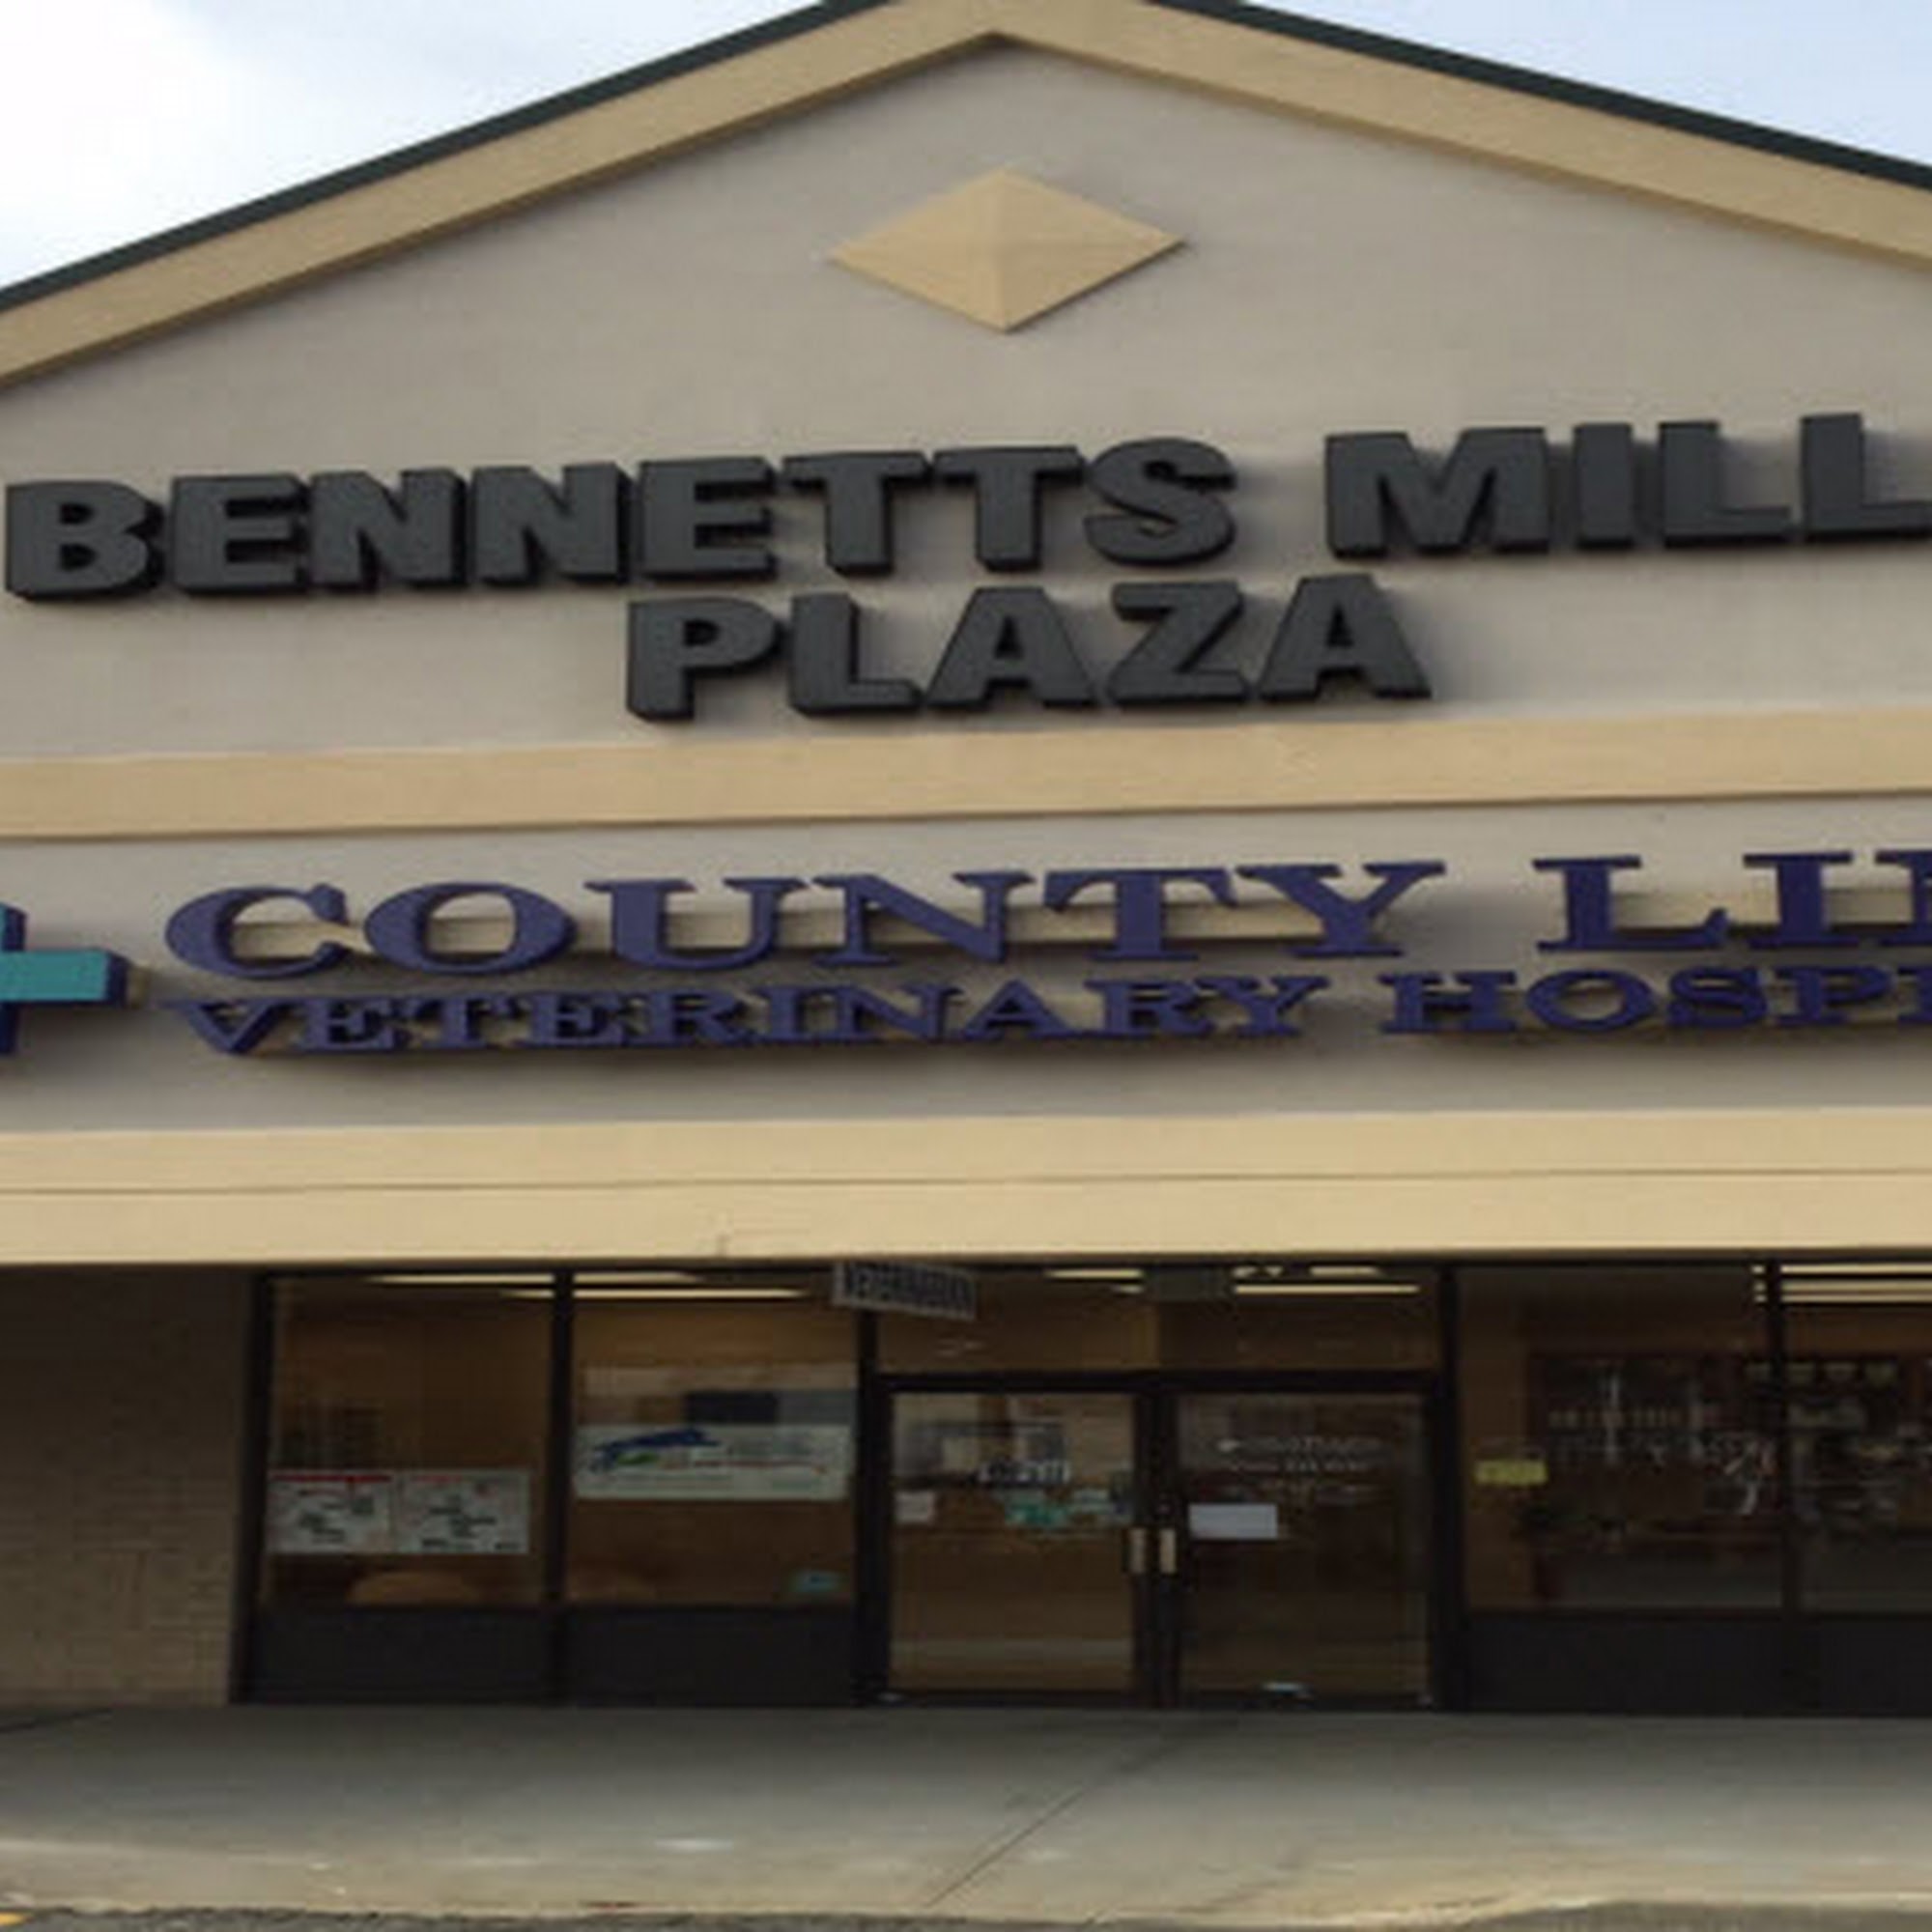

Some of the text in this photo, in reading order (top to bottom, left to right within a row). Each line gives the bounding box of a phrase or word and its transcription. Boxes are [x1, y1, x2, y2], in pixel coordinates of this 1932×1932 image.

[6, 413, 1932, 603] BENNETTS MILL
[627, 573, 1432, 720] PLAZA
[164, 850, 1932, 979] COUNTY LI
[159, 975, 1330, 1055] VETERINARY
